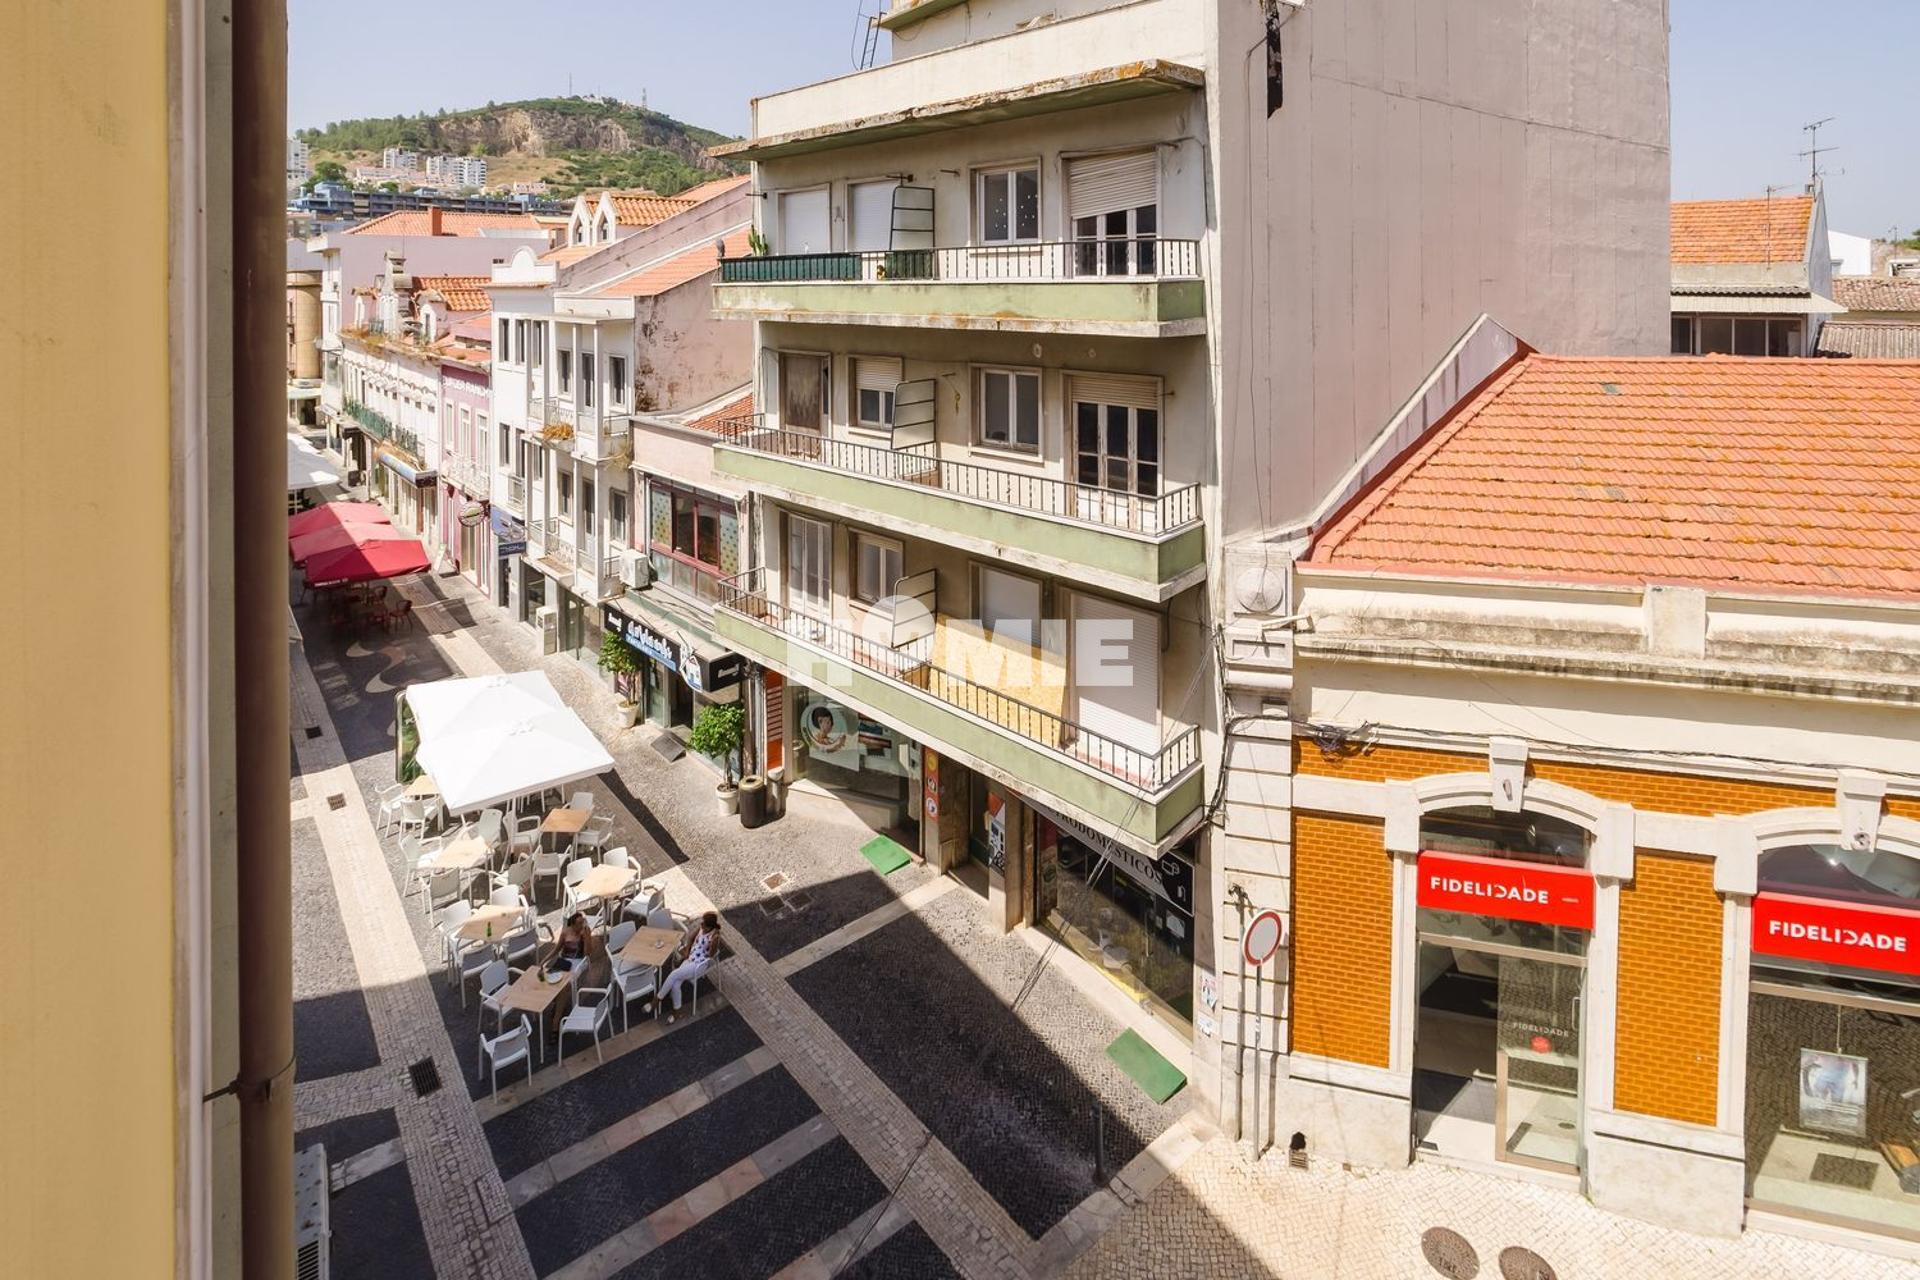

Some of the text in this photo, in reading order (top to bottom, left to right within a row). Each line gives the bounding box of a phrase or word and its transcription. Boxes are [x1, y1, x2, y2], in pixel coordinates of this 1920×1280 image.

[1430, 876, 1549, 904] FIDELIDADE
[1769, 919, 1907, 952] FIDELIDADE
[1512, 1022, 1569, 1037] FIDELIDADE
